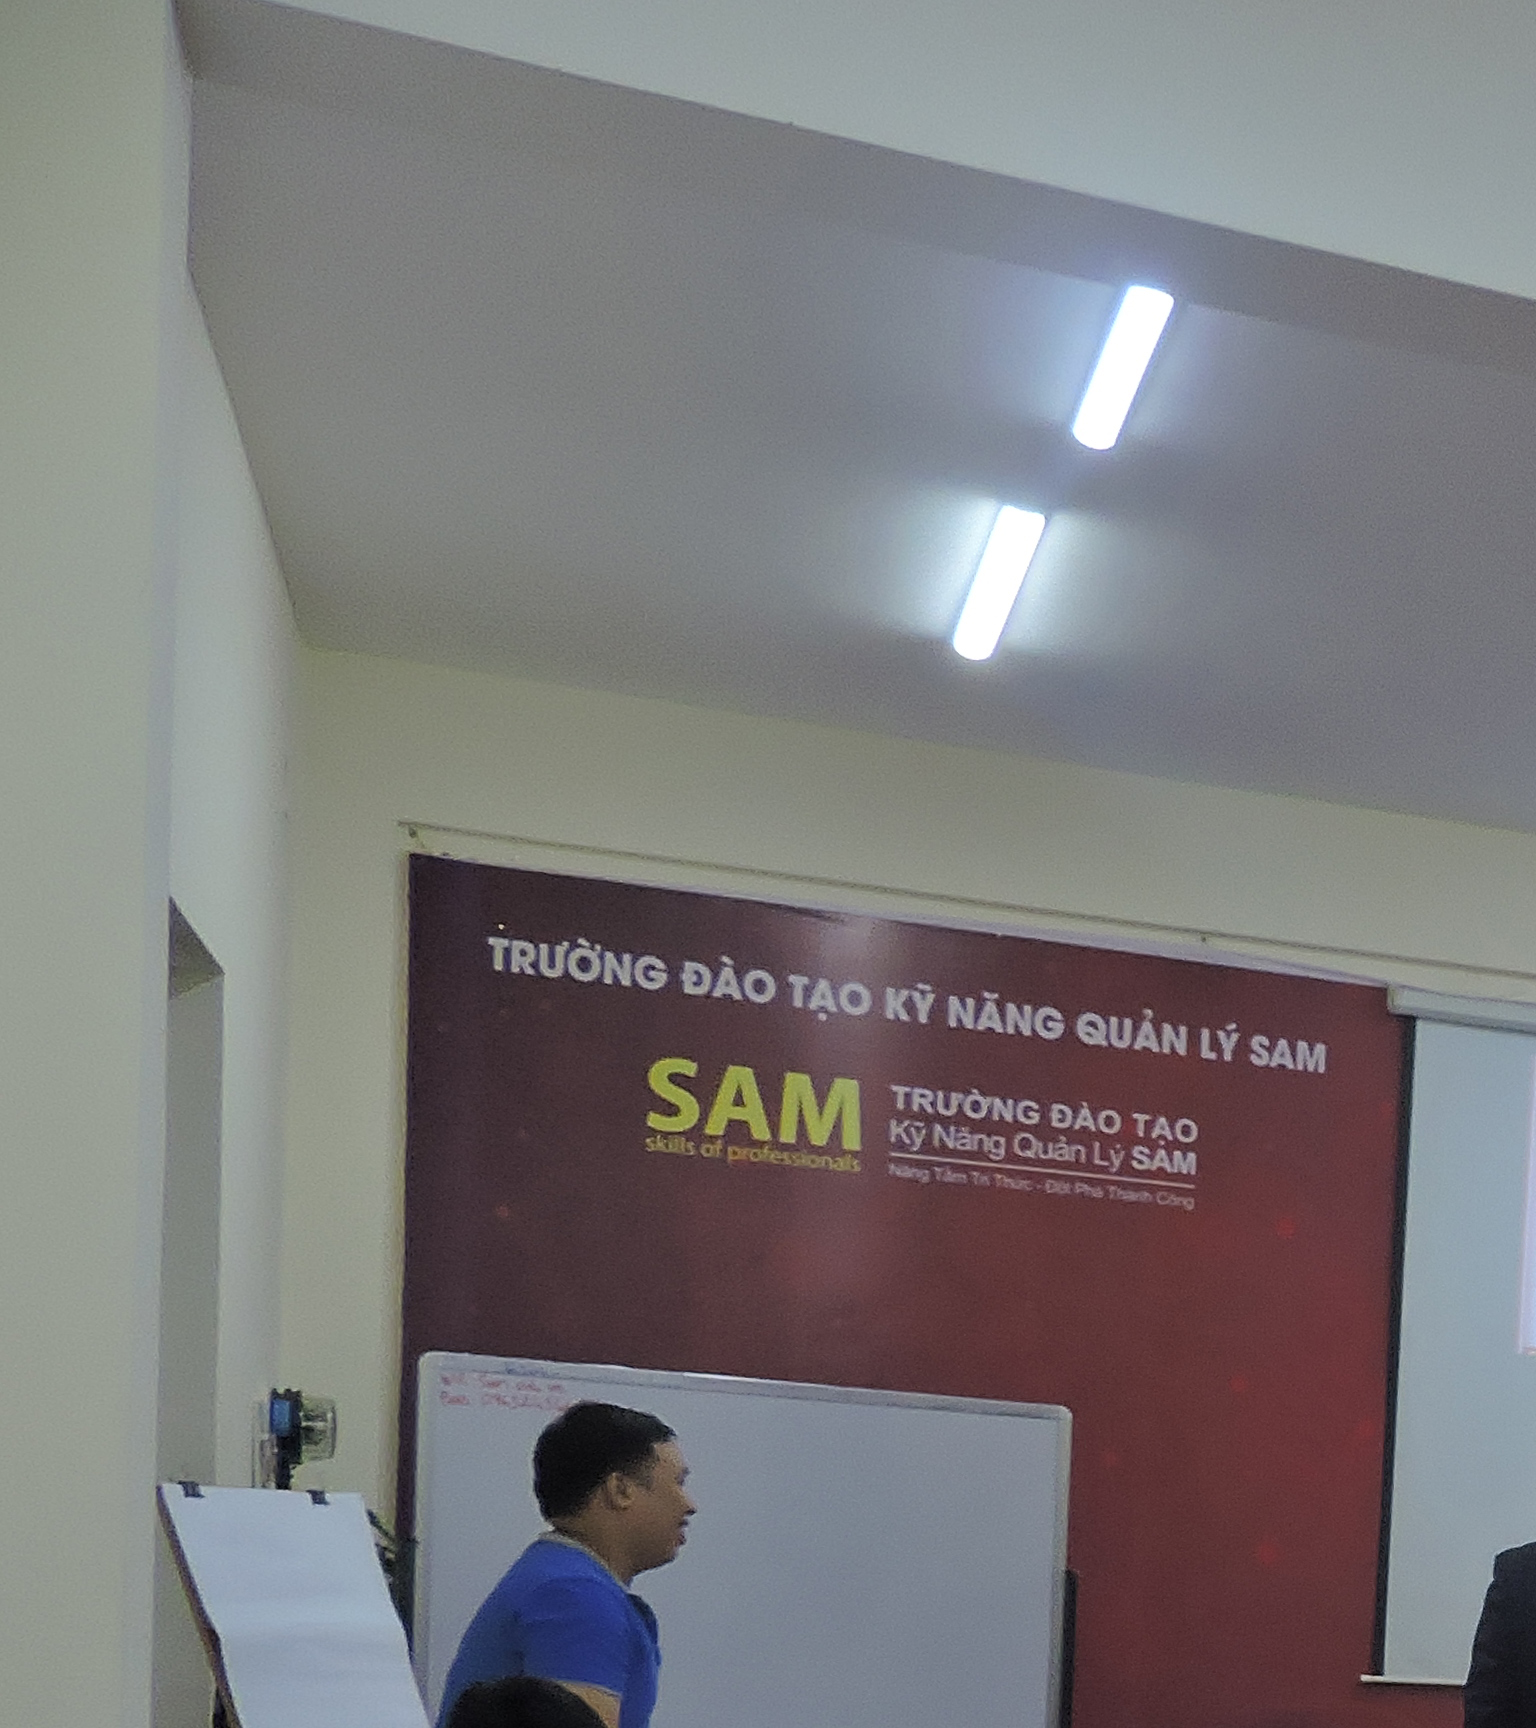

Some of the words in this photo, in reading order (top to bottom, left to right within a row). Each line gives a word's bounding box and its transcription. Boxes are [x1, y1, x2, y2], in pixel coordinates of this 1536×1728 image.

[487, 935, 669, 991] TRƯỜNG
[680, 955, 777, 1004] ĐÀO
[788, 973, 873, 1021] TẠO
[884, 983, 936, 1025] KỸ
[946, 991, 1066, 1041] NĂNG
[1075, 1008, 1189, 1056] QUẢN
[1199, 1022, 1242, 1062] LÝ
[1248, 1035, 1328, 1074] SAM
[646, 1056, 863, 1151] SAM
[890, 1084, 1041, 1125] TRƯỜNG
[1048, 1102, 1122, 1135] ĐÀO
[1132, 1112, 1199, 1145] TẠO
[645, 1135, 696, 1156] skills
[701, 1139, 722, 1158] of
[728, 1145, 862, 1172] professionals
[888, 1118, 927, 1152] Kỹ
[932, 1122, 1006, 1161] Năng
[1013, 1131, 1087, 1164] Quản
[1093, 1141, 1125, 1174] Lý
[1131, 1144, 1198, 1175] SAM
